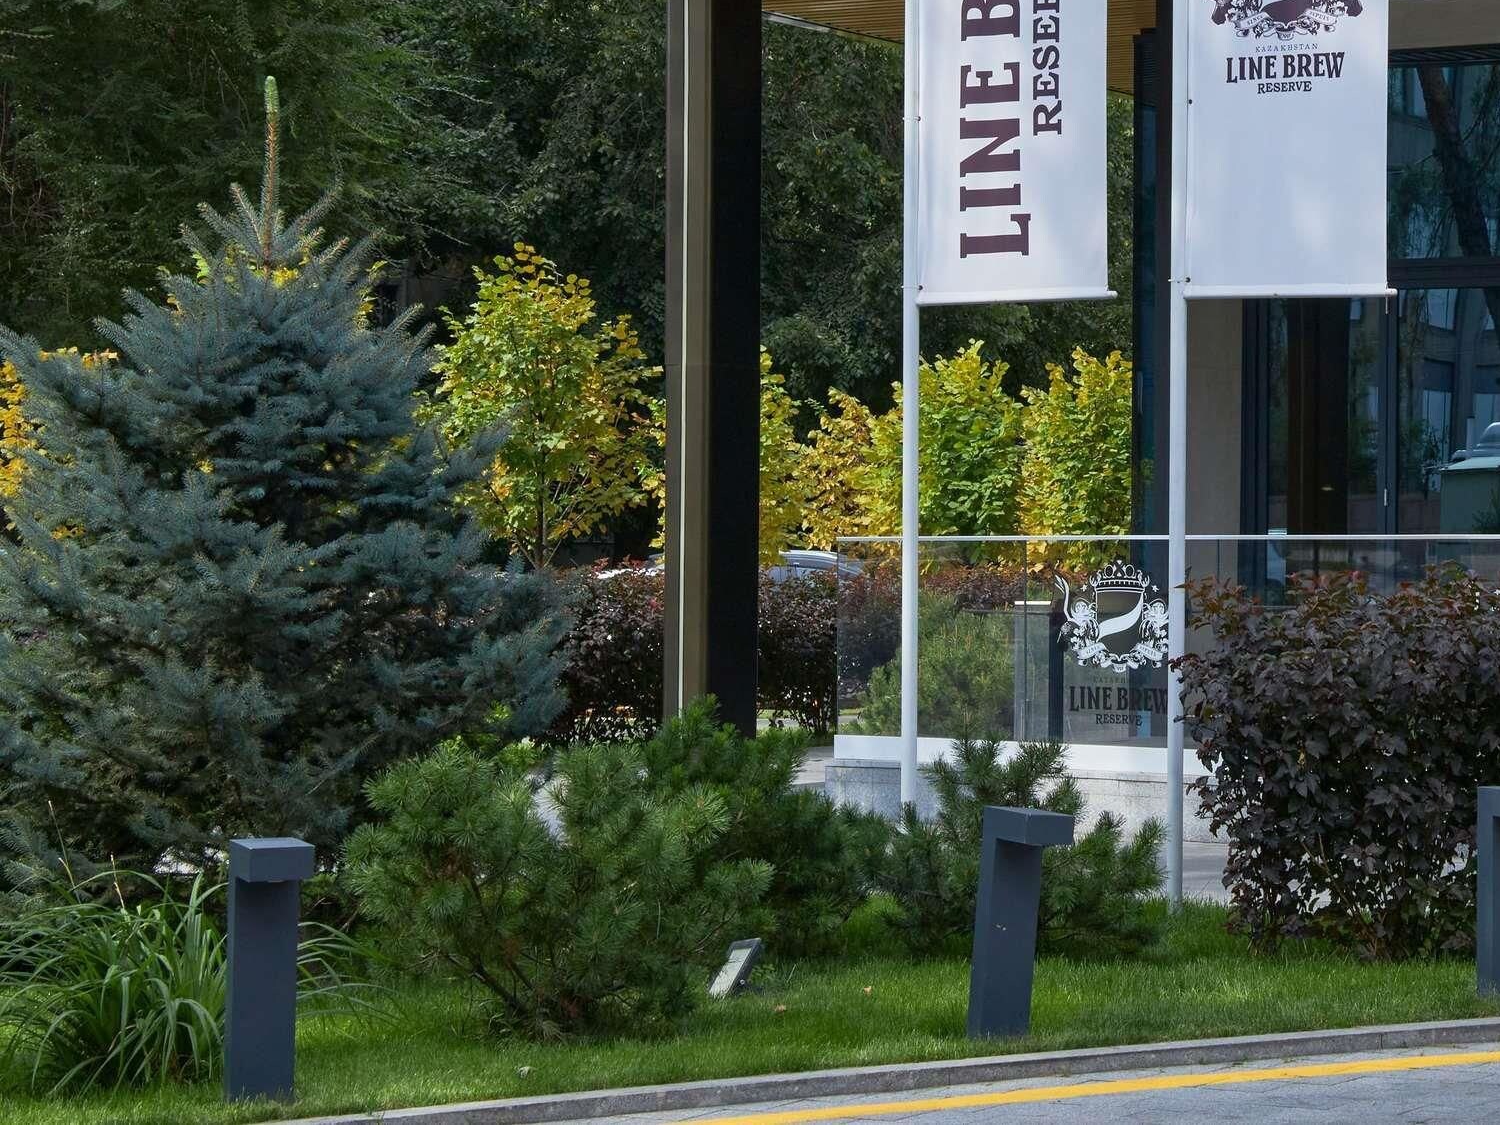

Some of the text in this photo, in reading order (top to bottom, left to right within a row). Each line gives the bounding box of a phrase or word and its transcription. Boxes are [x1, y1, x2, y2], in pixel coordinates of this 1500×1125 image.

[1226, 52, 1345, 83] LINE BREW
[1257, 81, 1312, 94] RESERVE
[959, 62, 1031, 259] LINE
[1069, 686, 1168, 714] LINE BREW
[1095, 713, 1143, 726] RESERVE
